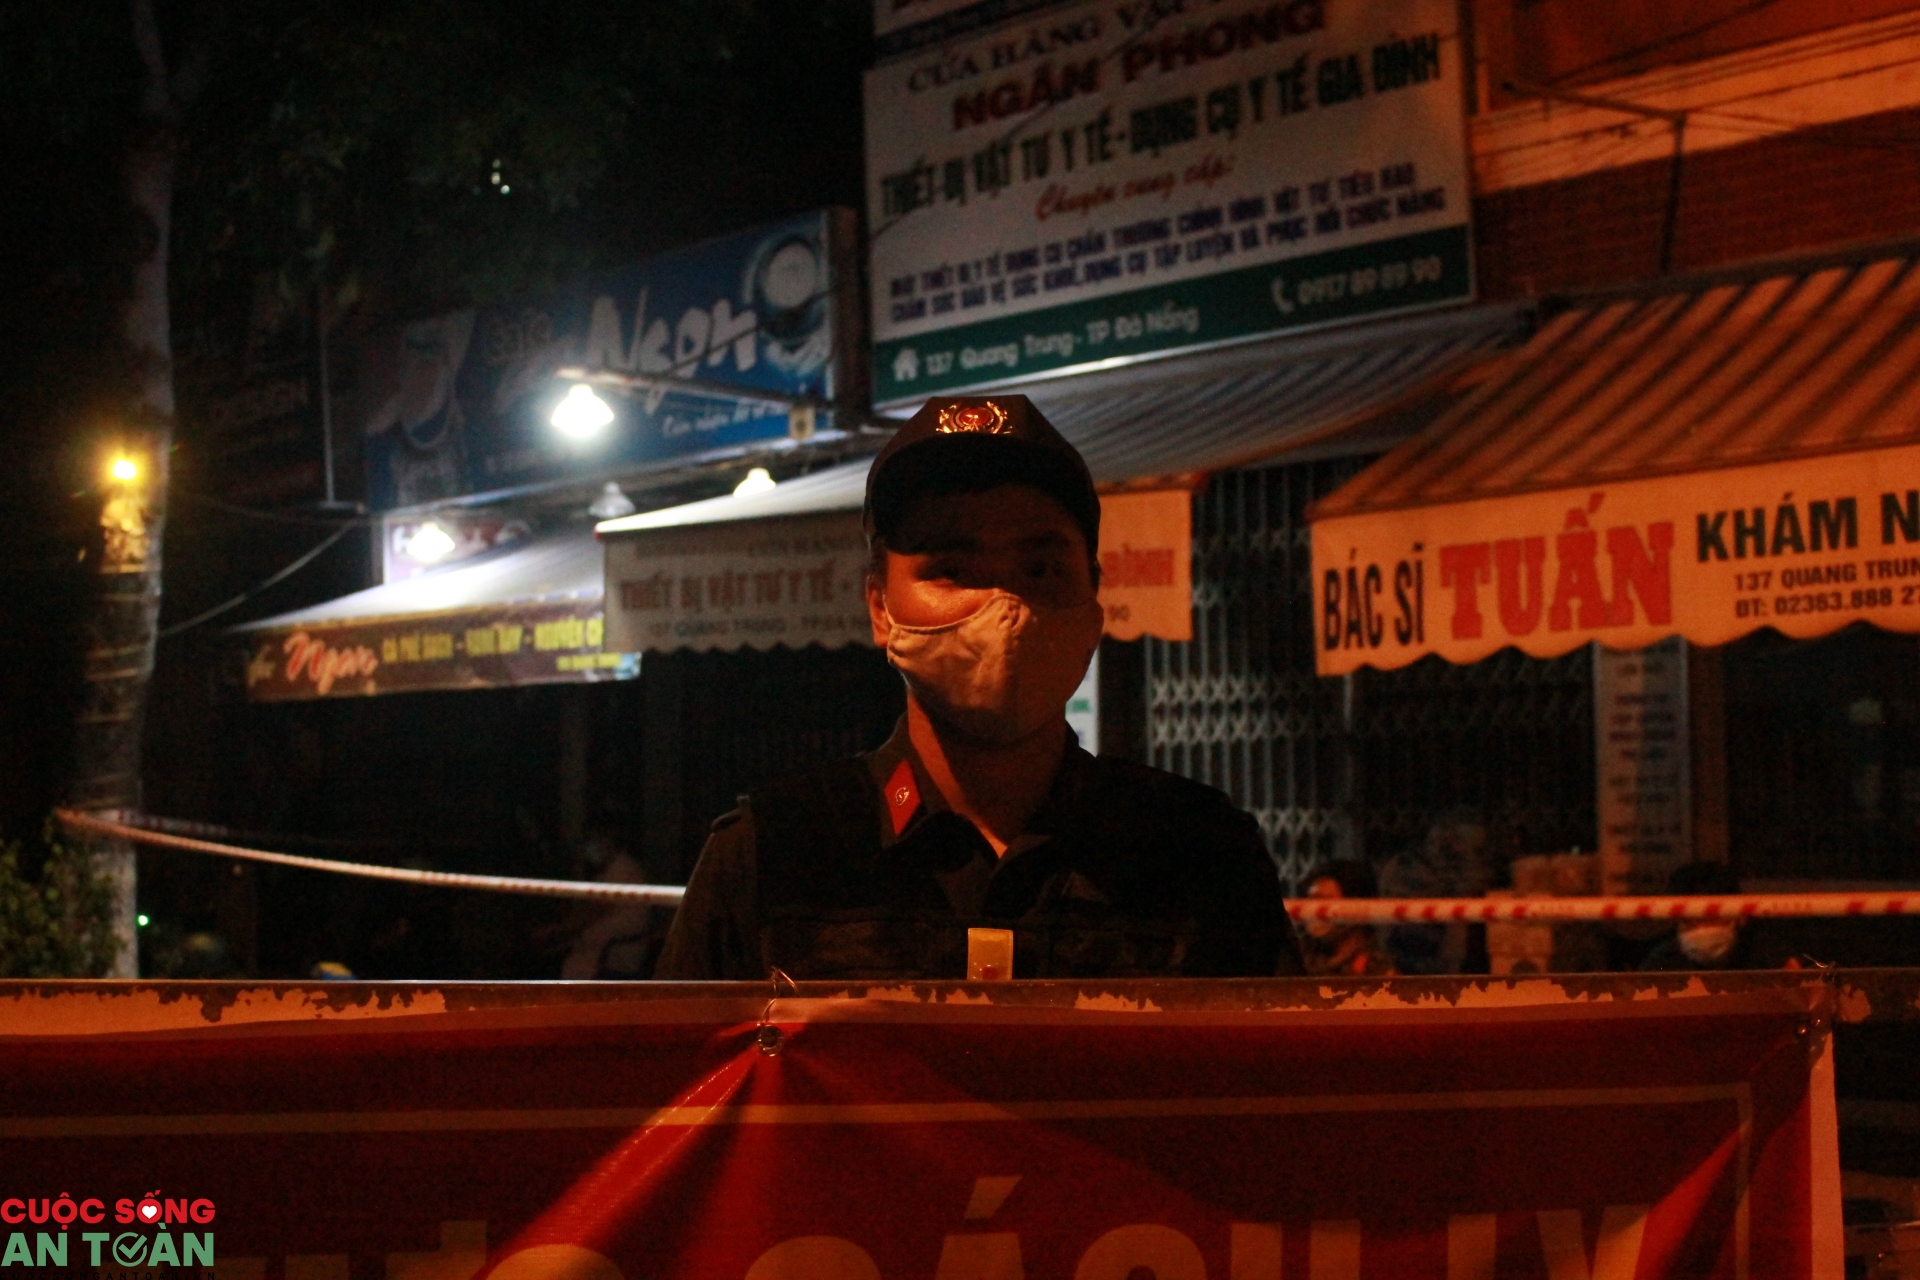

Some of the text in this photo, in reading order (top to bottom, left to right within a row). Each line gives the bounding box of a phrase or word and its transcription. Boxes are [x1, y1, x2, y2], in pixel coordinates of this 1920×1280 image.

[953, 0, 1323, 130] NGÂN PHONG
[992, 18, 1099, 69] HÀNG
[1061, 127, 1075, 172] Y
[1206, 84, 1240, 141] CỤ
[1249, 76, 1266, 121] Y
[1276, 55, 1307, 116] TẾ
[1317, 53, 1364, 106] GIA
[1372, 32, 1440, 92] ĐÌNH
[1035, 184, 1115, 222] Chuyên
[1123, 172, 1175, 200] cung
[925, 350, 954, 377] 137
[958, 340, 1019, 369] Quang
[1086, 319, 1111, 346] TP
[1411, 254, 1443, 284] 90
[1322, 547, 1384, 651] BÁC
[1438, 492, 1675, 640] TUẤN
[1695, 491, 1859, 563] KHÁM
[1735, 570, 1774, 592] 137
[1780, 563, 1858, 590] QUANG
